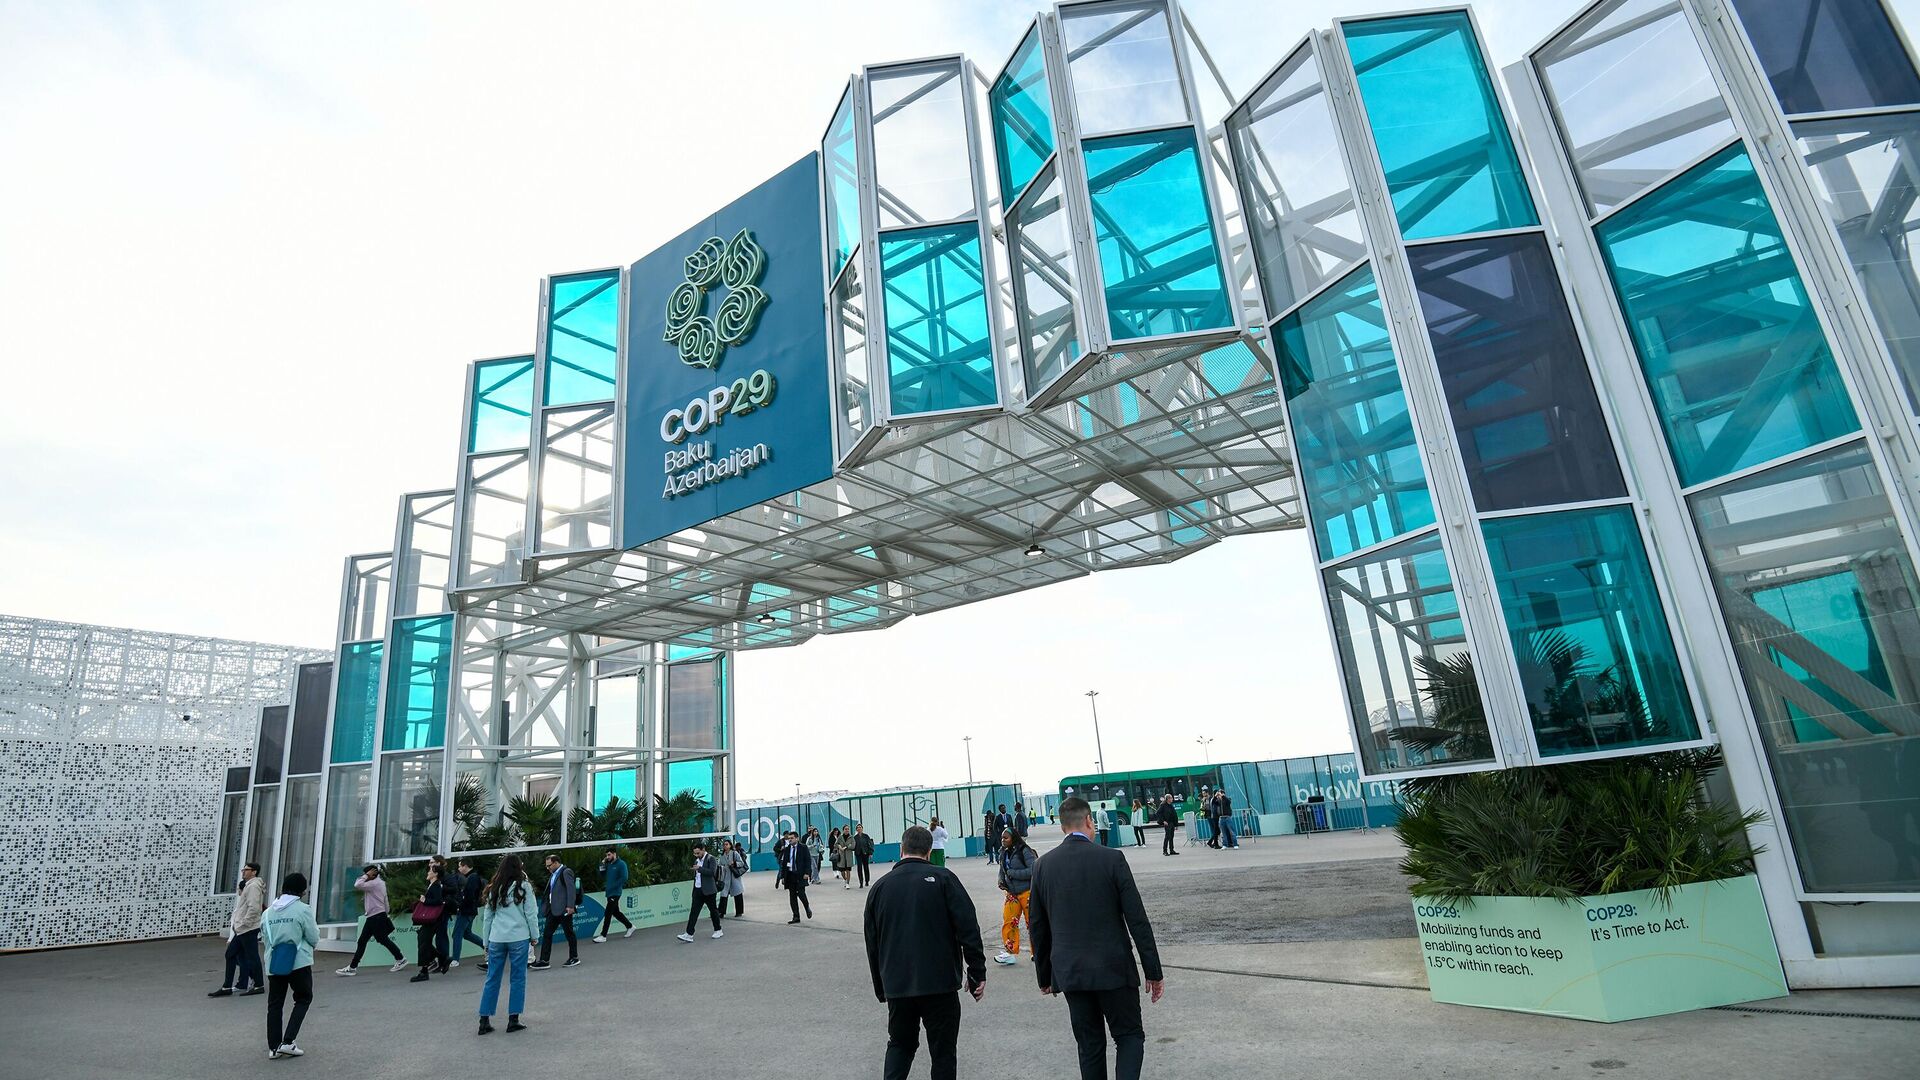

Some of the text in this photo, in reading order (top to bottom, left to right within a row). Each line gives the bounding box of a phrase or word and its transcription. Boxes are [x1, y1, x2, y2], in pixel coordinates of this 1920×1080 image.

[660, 369, 773, 443] COP29
[664, 440, 711, 474] Baku
[662, 443, 768, 499] Azerbaijan
[268, 917, 293, 926] OLUNTEER
[1417, 905, 1461, 919] COP29:
[1586, 904, 1638, 922] COP29:
[1420, 922, 1542, 940] Mobilizing funds and
[1590, 917, 1689, 941] It's Time to Act.
[1424, 941, 1563, 961] enabling action to keep
[1427, 956, 1534, 976] 1.5°C within reach.
